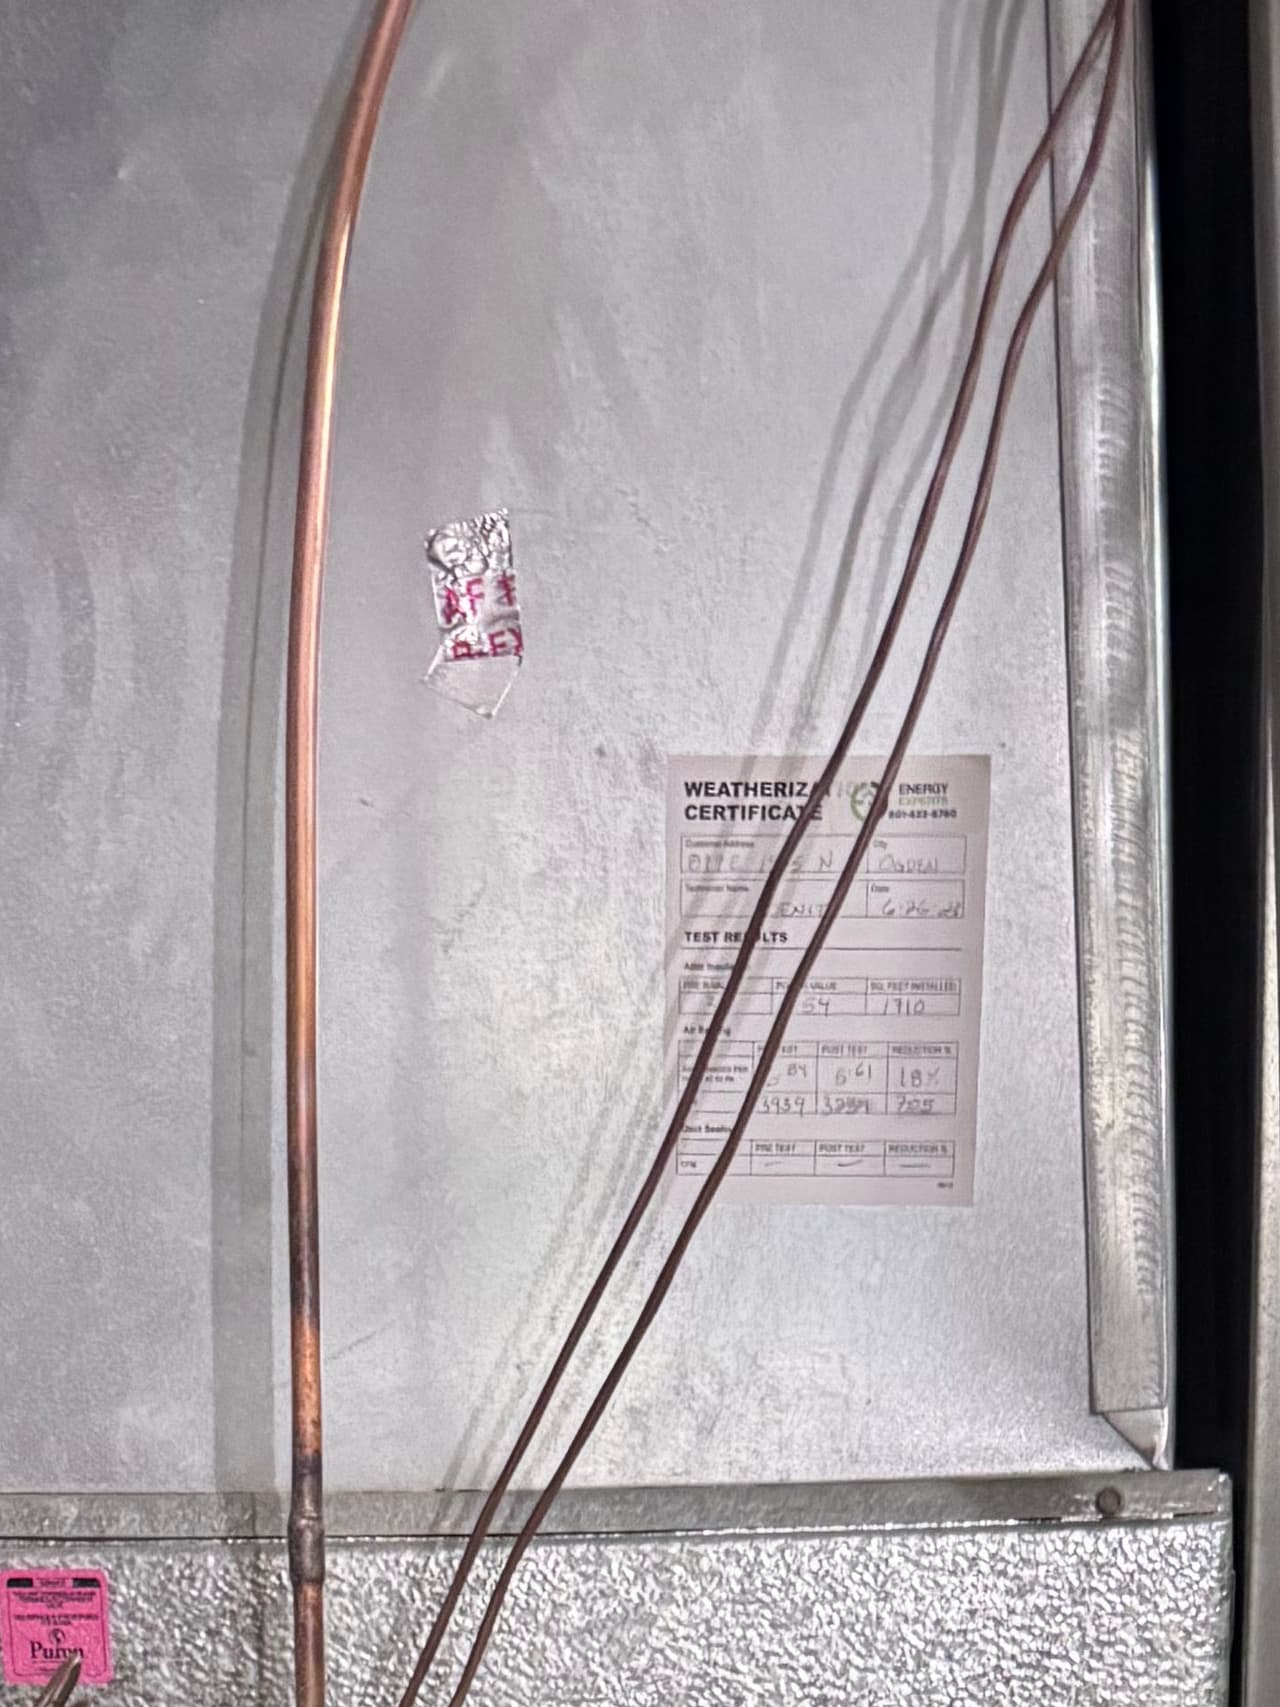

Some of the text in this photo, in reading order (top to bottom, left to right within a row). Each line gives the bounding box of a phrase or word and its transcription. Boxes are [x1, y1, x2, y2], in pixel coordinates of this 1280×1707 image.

[898, 783, 949, 795] ENERGY
[685, 932, 788, 943] TEST RELTS
